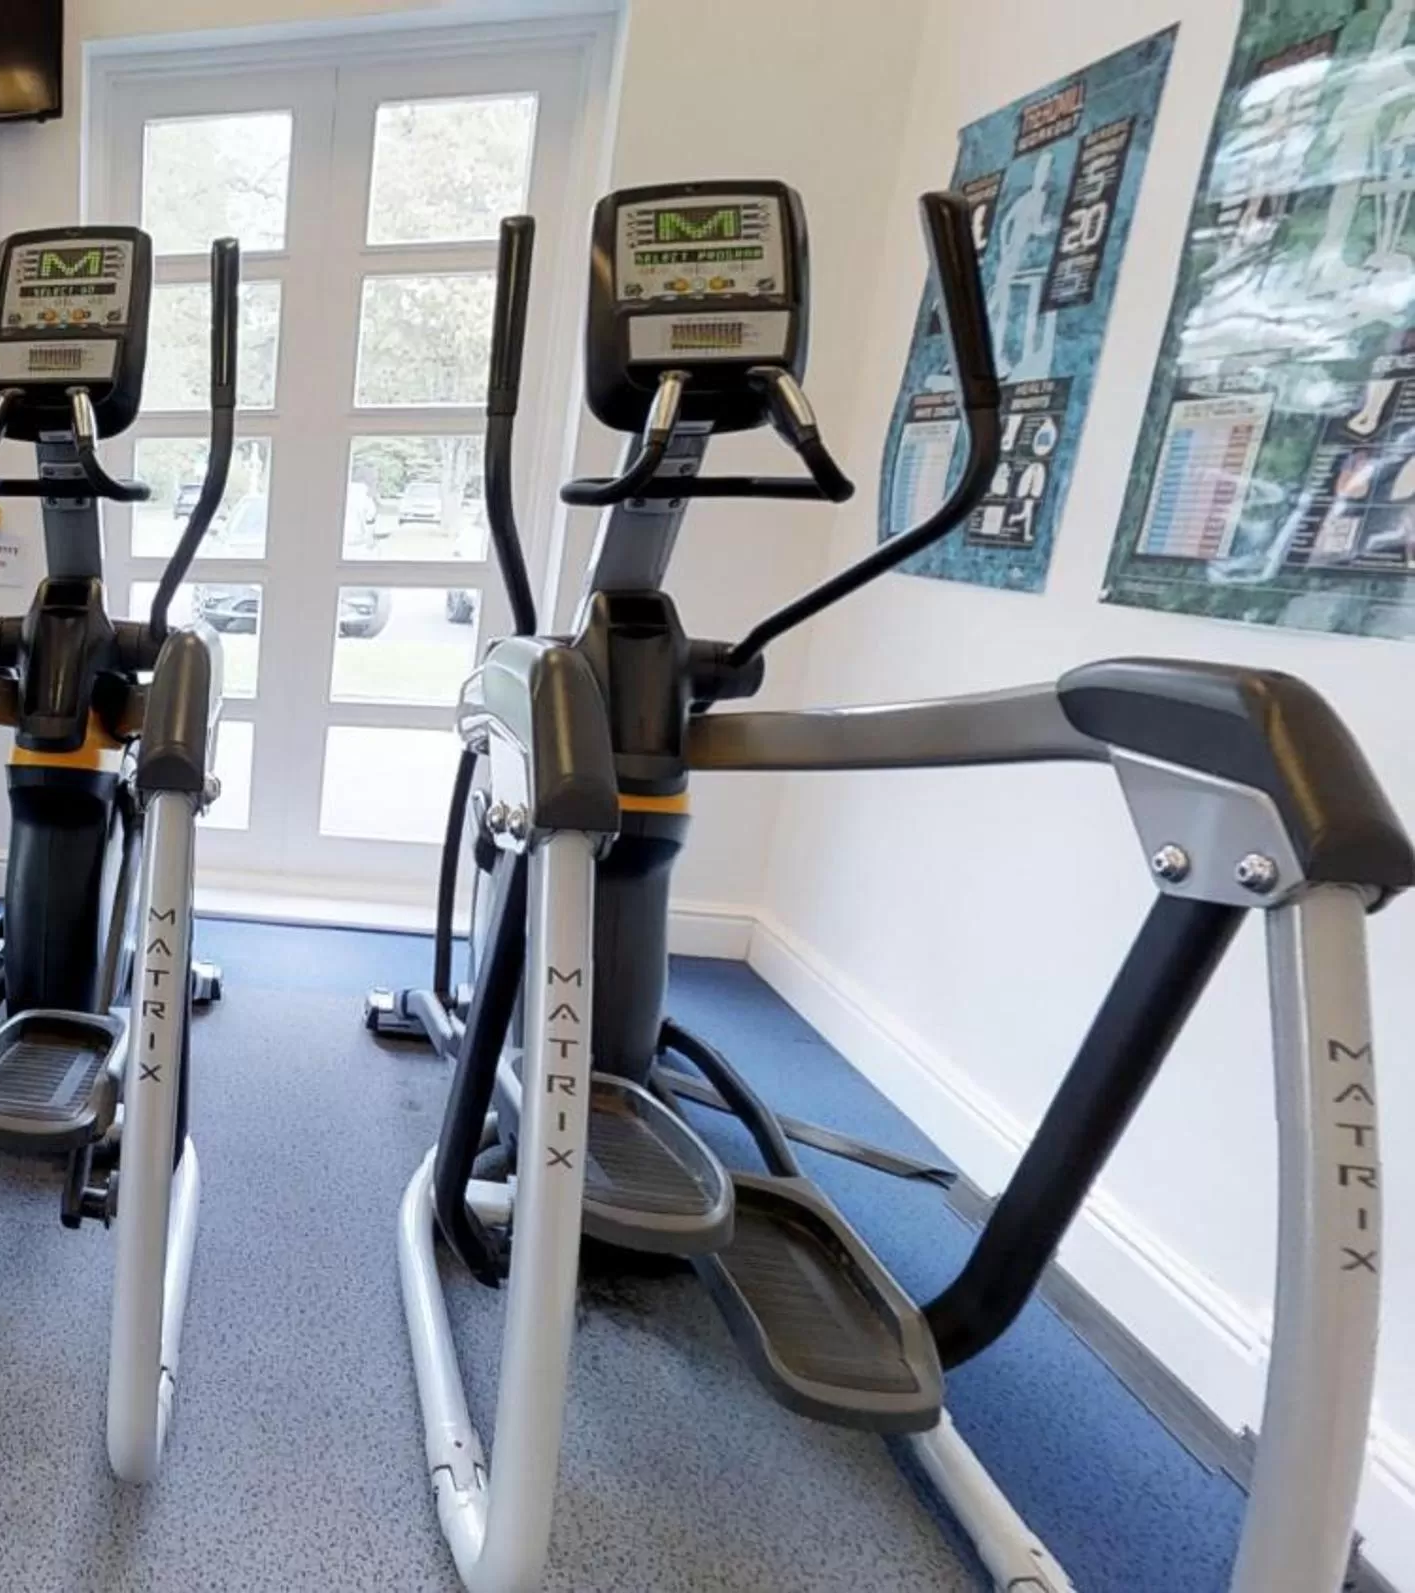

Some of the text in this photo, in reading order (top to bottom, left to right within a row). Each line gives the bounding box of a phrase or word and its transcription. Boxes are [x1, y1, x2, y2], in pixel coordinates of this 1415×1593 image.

[1060, 202, 1108, 253] 20
[138, 905, 177, 1083] MATRIX
[545, 965, 583, 1170] MATRIX
[1327, 1038, 1379, 1275] MATRIX
